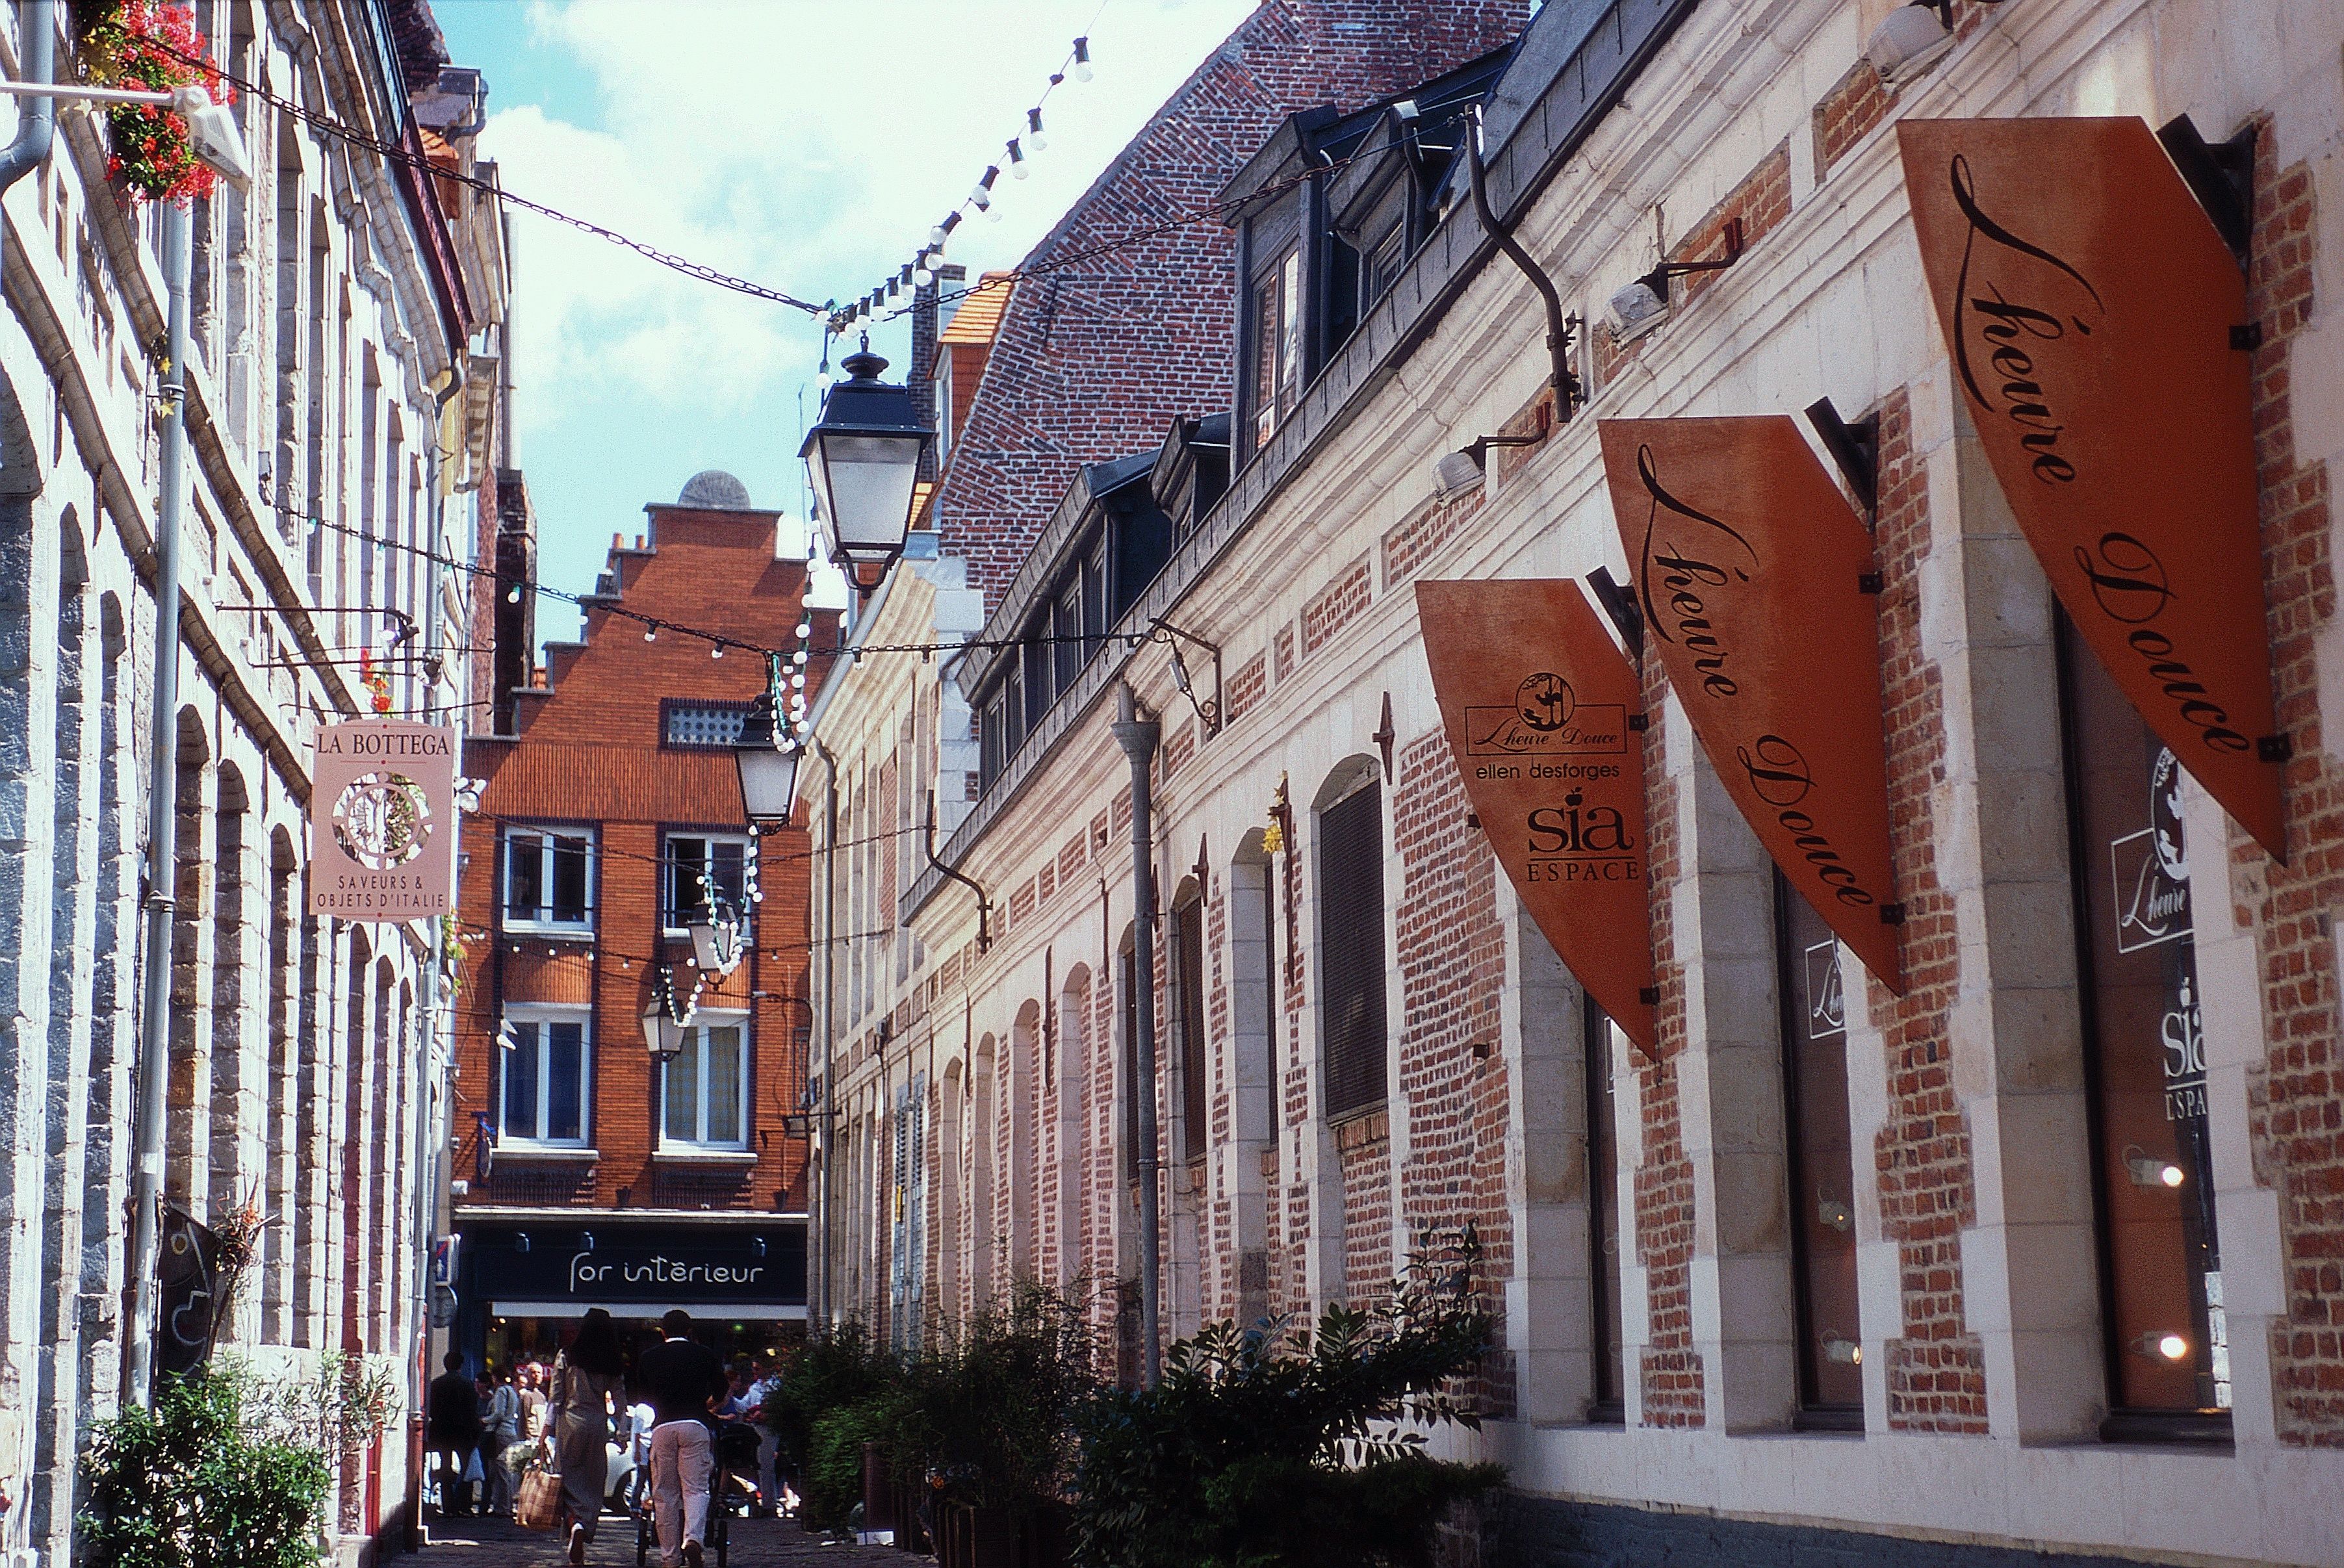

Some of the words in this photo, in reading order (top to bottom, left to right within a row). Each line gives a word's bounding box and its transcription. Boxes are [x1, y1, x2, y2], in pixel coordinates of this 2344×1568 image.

[1950, 153, 2106, 485] L'heure
[2075, 532, 2250, 754] Douce
[1638, 443, 1759, 700] L'heure
[1736, 734, 1875, 908] Douce
[318, 734, 342, 754] LA
[353, 734, 450, 755] BOTTEGA
[1474, 716, 1550, 752] L'heure
[1562, 727, 1617, 745] Douce
[1476, 764, 1521, 778] ellen
[1529, 763, 1620, 780] desforges
[1527, 786, 1635, 853] sia
[339, 875, 407, 890] SAVEURS
[415, 875, 422, 890] &
[1527, 860, 1640, 882] ESPACE
[317, 893, 372, 907] OBJETS
[380, 893, 443, 907] D'ITALIE
[2165, 1088, 2207, 1120] ESPA
